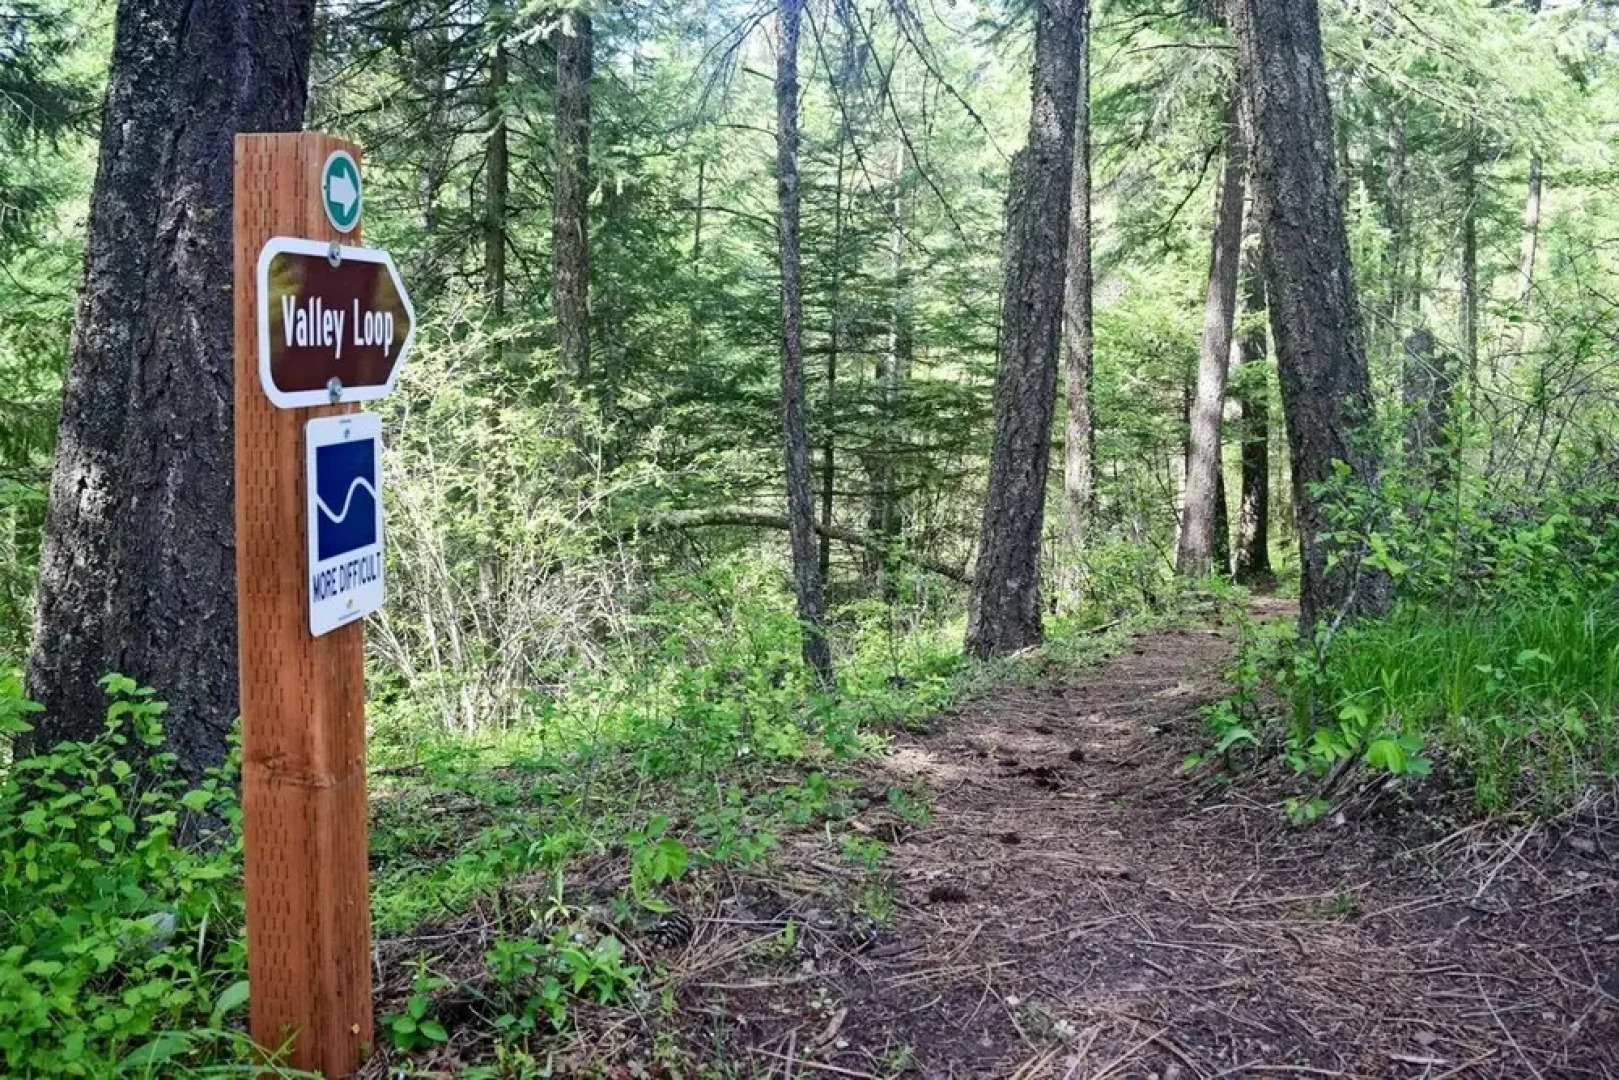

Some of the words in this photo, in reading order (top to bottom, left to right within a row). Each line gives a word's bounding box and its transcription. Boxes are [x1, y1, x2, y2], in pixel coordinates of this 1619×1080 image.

[282, 295, 345, 359] Valley
[353, 298, 394, 358] Loop
[313, 567, 337, 602] MORE
[340, 551, 381, 592] DIFFICULT
